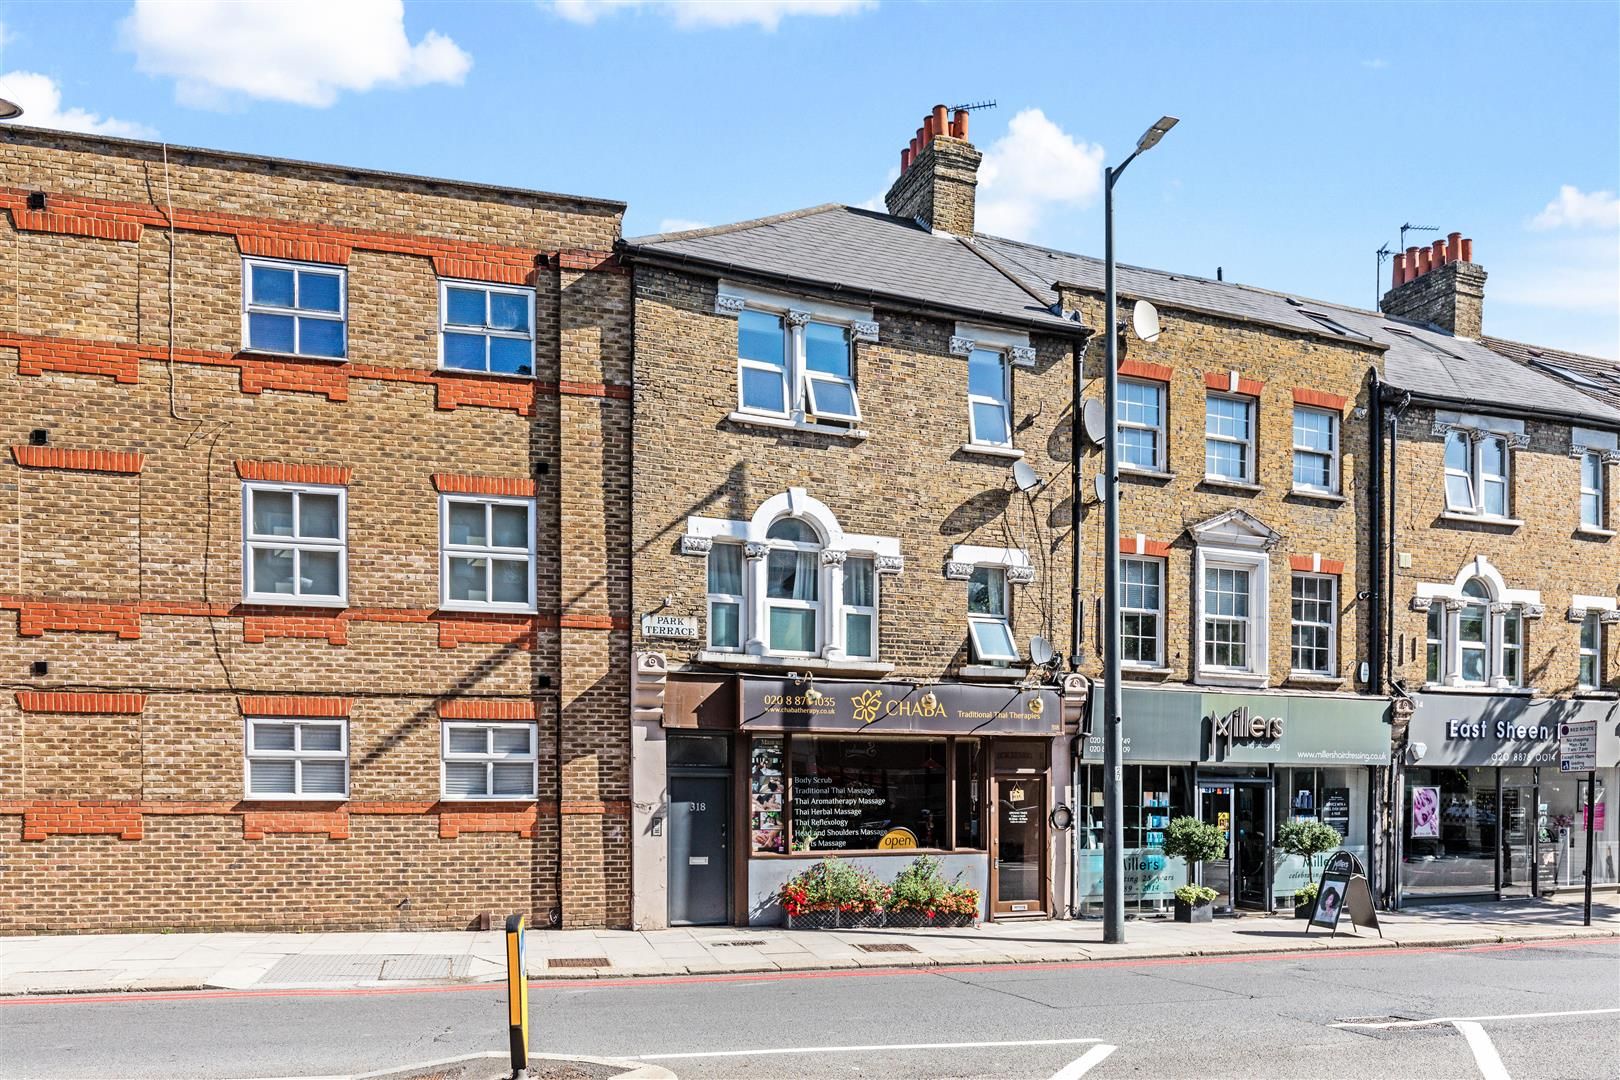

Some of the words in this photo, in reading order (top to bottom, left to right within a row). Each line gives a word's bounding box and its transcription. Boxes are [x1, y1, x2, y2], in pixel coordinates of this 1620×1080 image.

[657, 616, 684, 625] PARK
[645, 625, 695, 636] TERRACE
[764, 694, 783, 705] 020
[785, 695, 792, 705] 8
[885, 699, 948, 718] CHABA
[957, 710, 993, 719] Traditional
[994, 711, 1008, 719] Thai
[1010, 711, 1041, 720] Therapies
[1210, 706, 1284, 757] Millers
[1449, 719, 1487, 738] East
[1496, 720, 1549, 740] Sheen
[1089, 736, 1101, 744] 020
[1089, 745, 1101, 753] 020
[1297, 750, 1387, 762] www.millershairdressing.co.uk
[1491, 752, 1510, 762] 020
[794, 776, 811, 785] Body
[812, 776, 833, 784] Scrub
[794, 786, 830, 795] Traditional
[831, 786, 846, 794] Thai
[847, 787, 875, 796] Massage
[794, 797, 810, 806] Thai
[810, 798, 858, 806] Aromatherapy
[858, 798, 886, 806] Massage
[689, 802, 706, 812] 318
[794, 808, 810, 816] Thai
[810, 808, 833, 816] Herbal
[833, 808, 862, 817] Massage
[794, 819, 810, 827] Thai
[810, 818, 849, 827] Reflexology
[795, 829, 812, 837] Head
[812, 829, 826, 837] and
[827, 828, 860, 837] Shoulders
[860, 828, 888, 837] Massage
[817, 839, 847, 848] Massage
[884, 835, 912, 849] open
[1302, 855, 1329, 868] Mille
